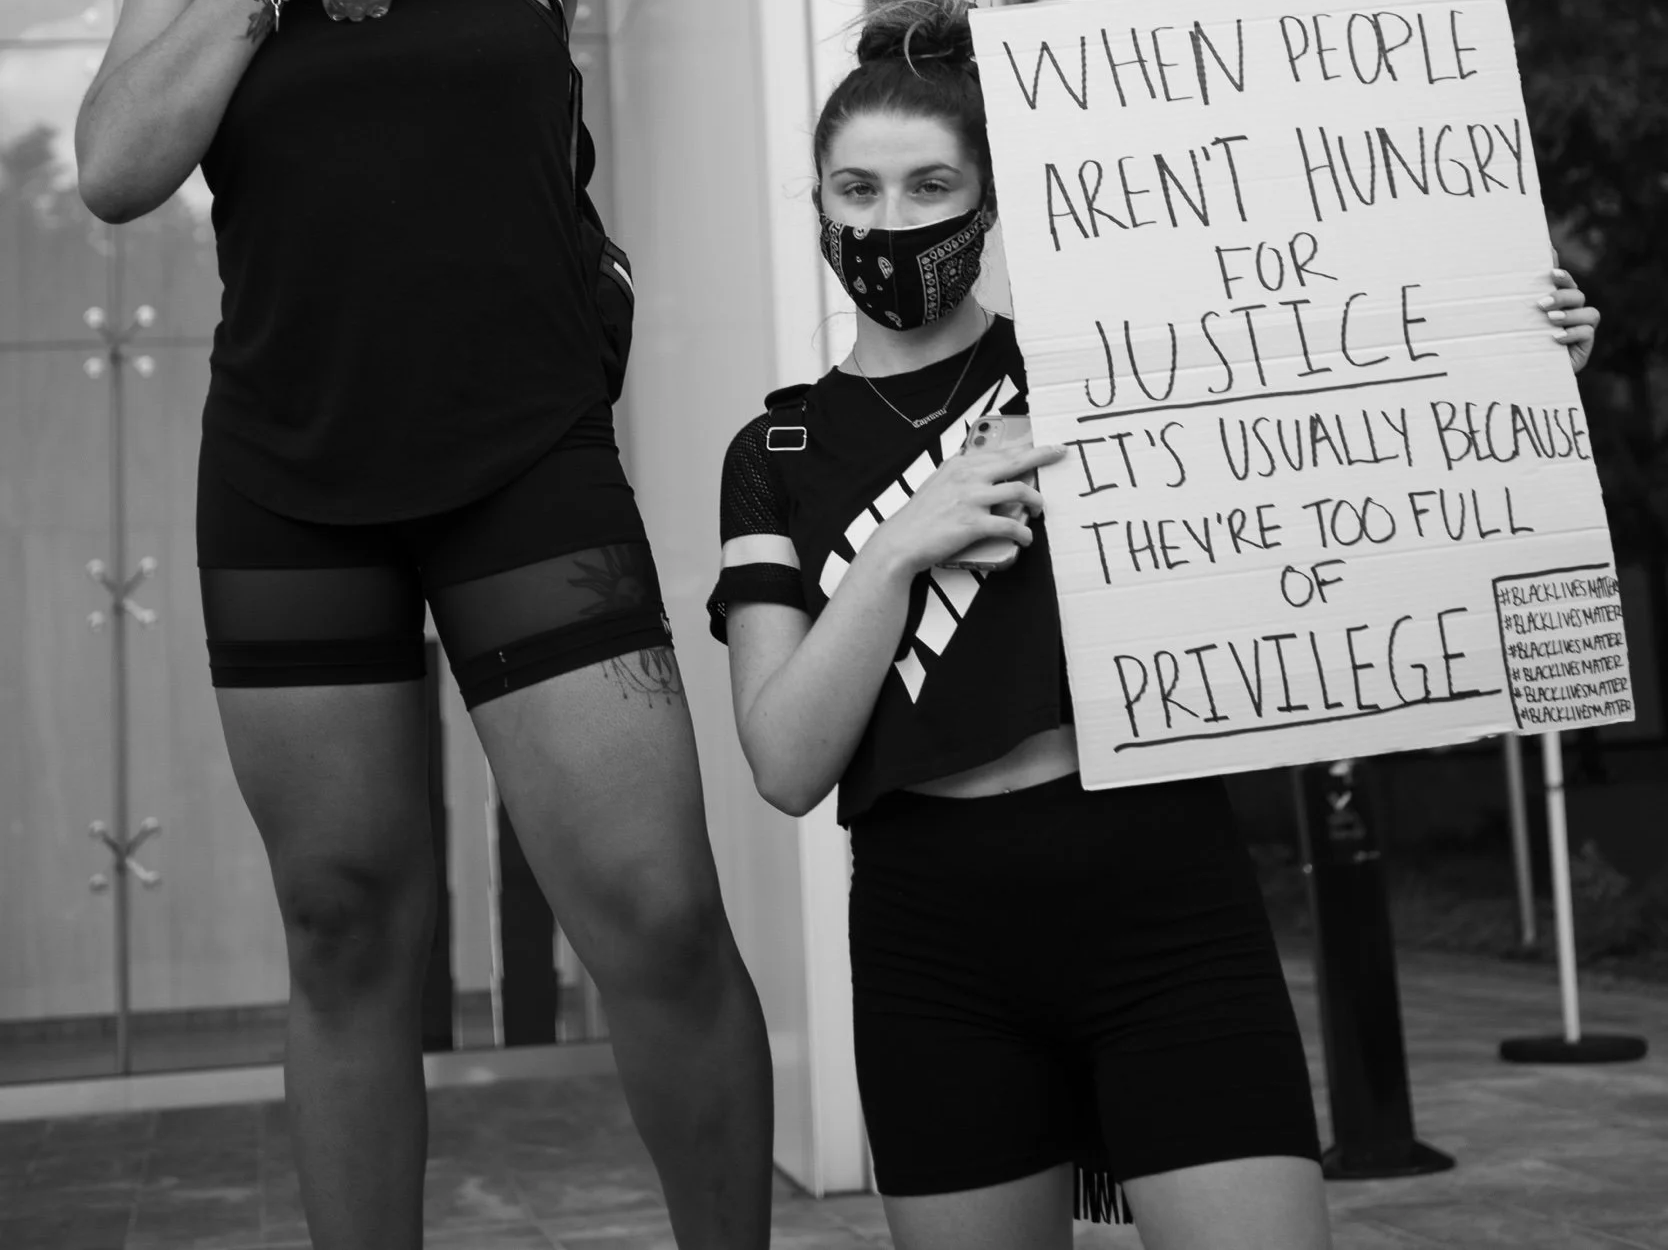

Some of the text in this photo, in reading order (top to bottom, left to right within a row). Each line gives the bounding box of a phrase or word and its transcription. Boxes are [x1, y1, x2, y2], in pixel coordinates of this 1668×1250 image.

[1002, 9, 1478, 110] WHEN PEOPLE
[1045, 118, 1526, 252] AREN'T HUNGRY
[1215, 231, 1338, 300] FOR
[1085, 284, 1440, 408] JUSTICE
[1062, 400, 1591, 497] IT'S USUALLY BECAUSE
[1081, 486, 1535, 585] THEY'RE TOO FULL
[1280, 559, 1346, 607] OF
[1113, 608, 1501, 738] PRIVILEGE
